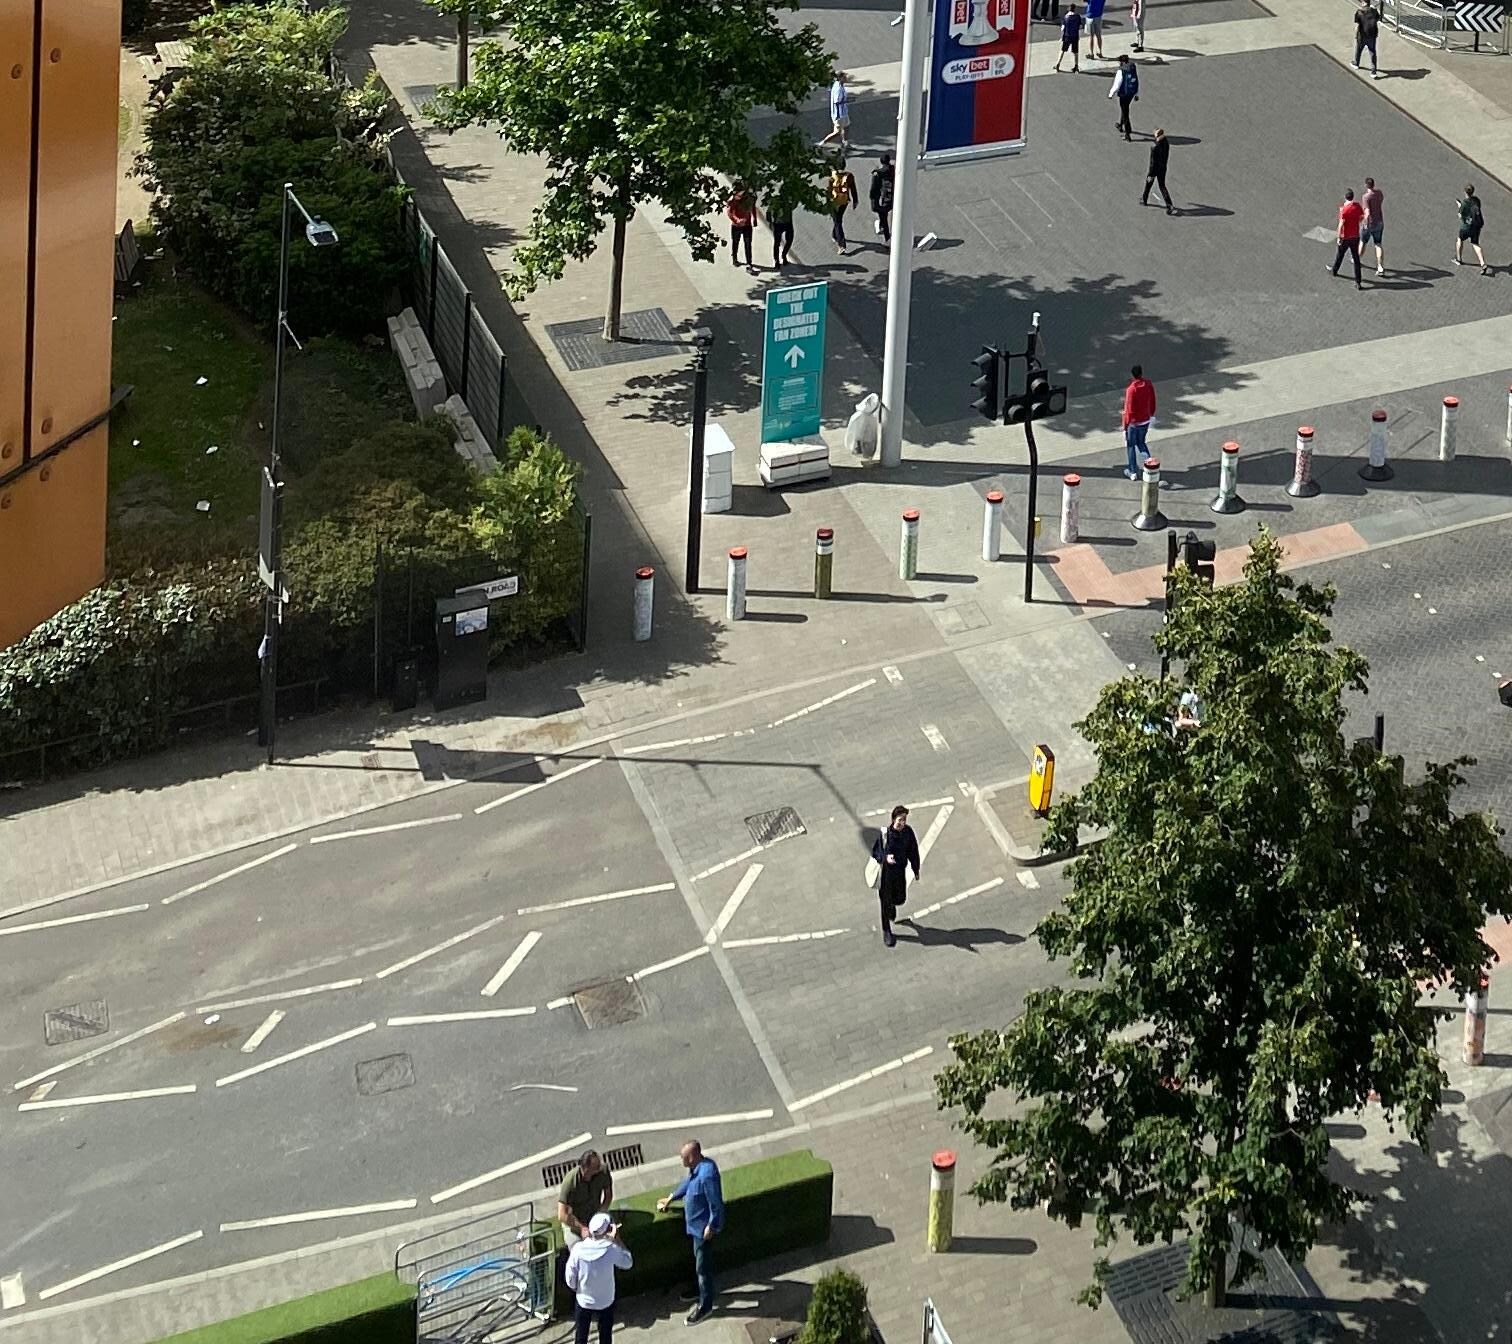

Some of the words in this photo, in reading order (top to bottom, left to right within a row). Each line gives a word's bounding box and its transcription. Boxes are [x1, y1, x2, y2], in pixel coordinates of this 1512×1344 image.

[956, 0, 967, 23] bet
[951, 63, 968, 73] sky
[971, 61, 987, 70] bet
